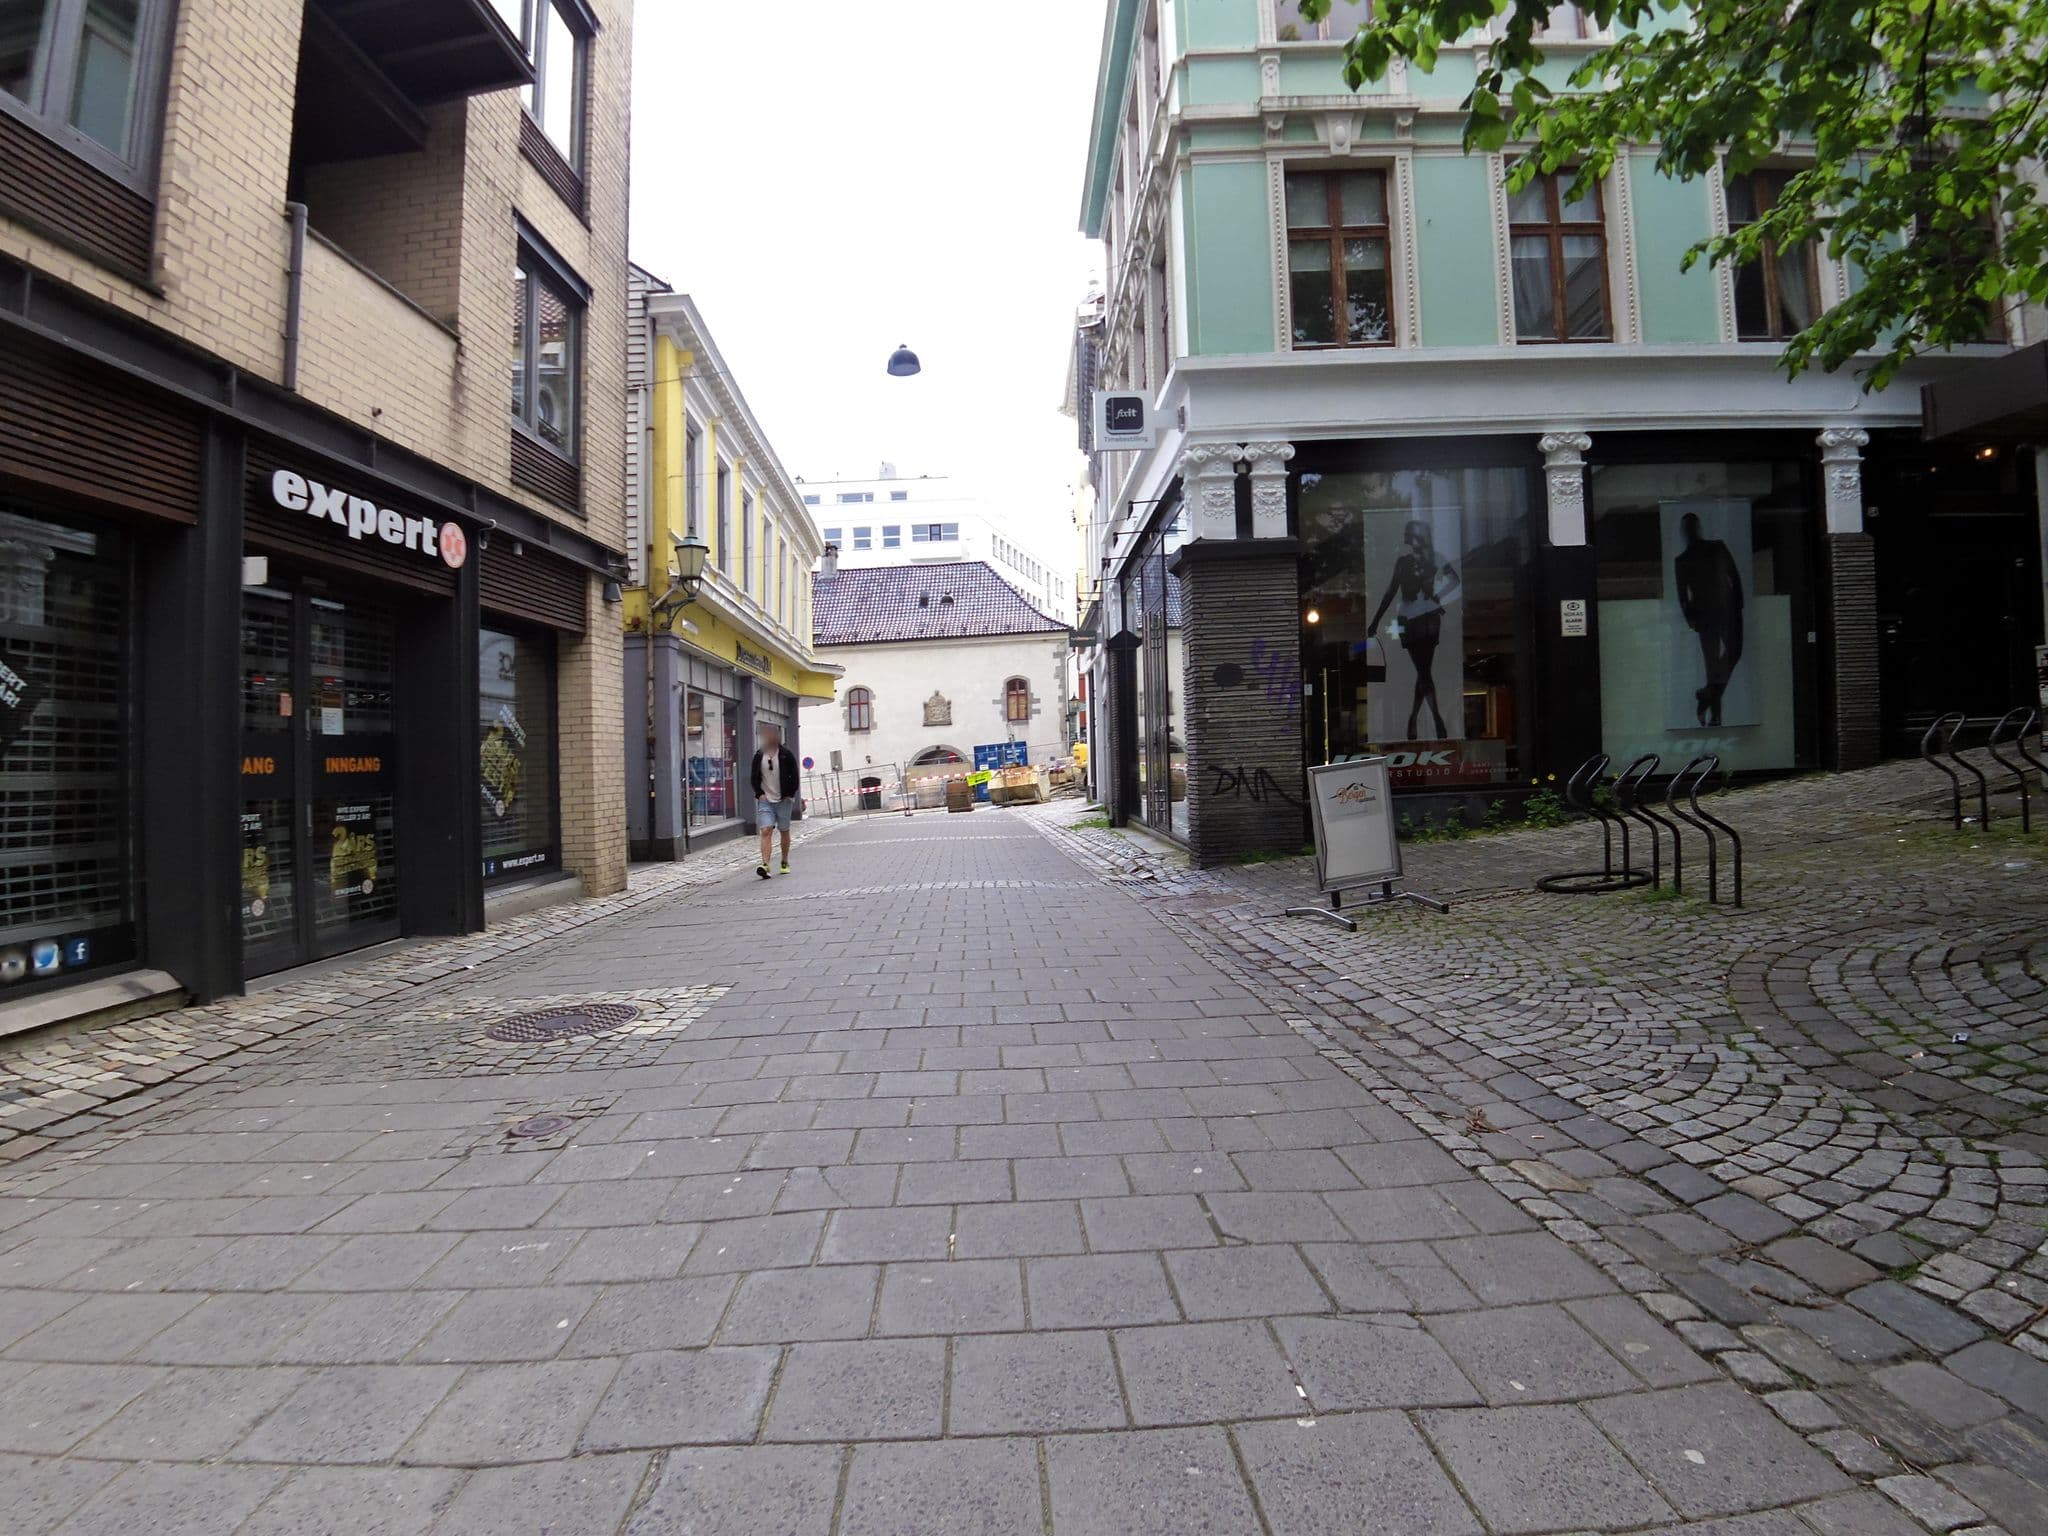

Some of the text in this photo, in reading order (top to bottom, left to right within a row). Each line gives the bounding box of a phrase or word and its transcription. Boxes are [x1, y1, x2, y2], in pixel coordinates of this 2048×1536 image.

[1115, 408, 1138, 420] fixit
[272, 469, 438, 557] expert
[325, 757, 381, 773] INNGANG
